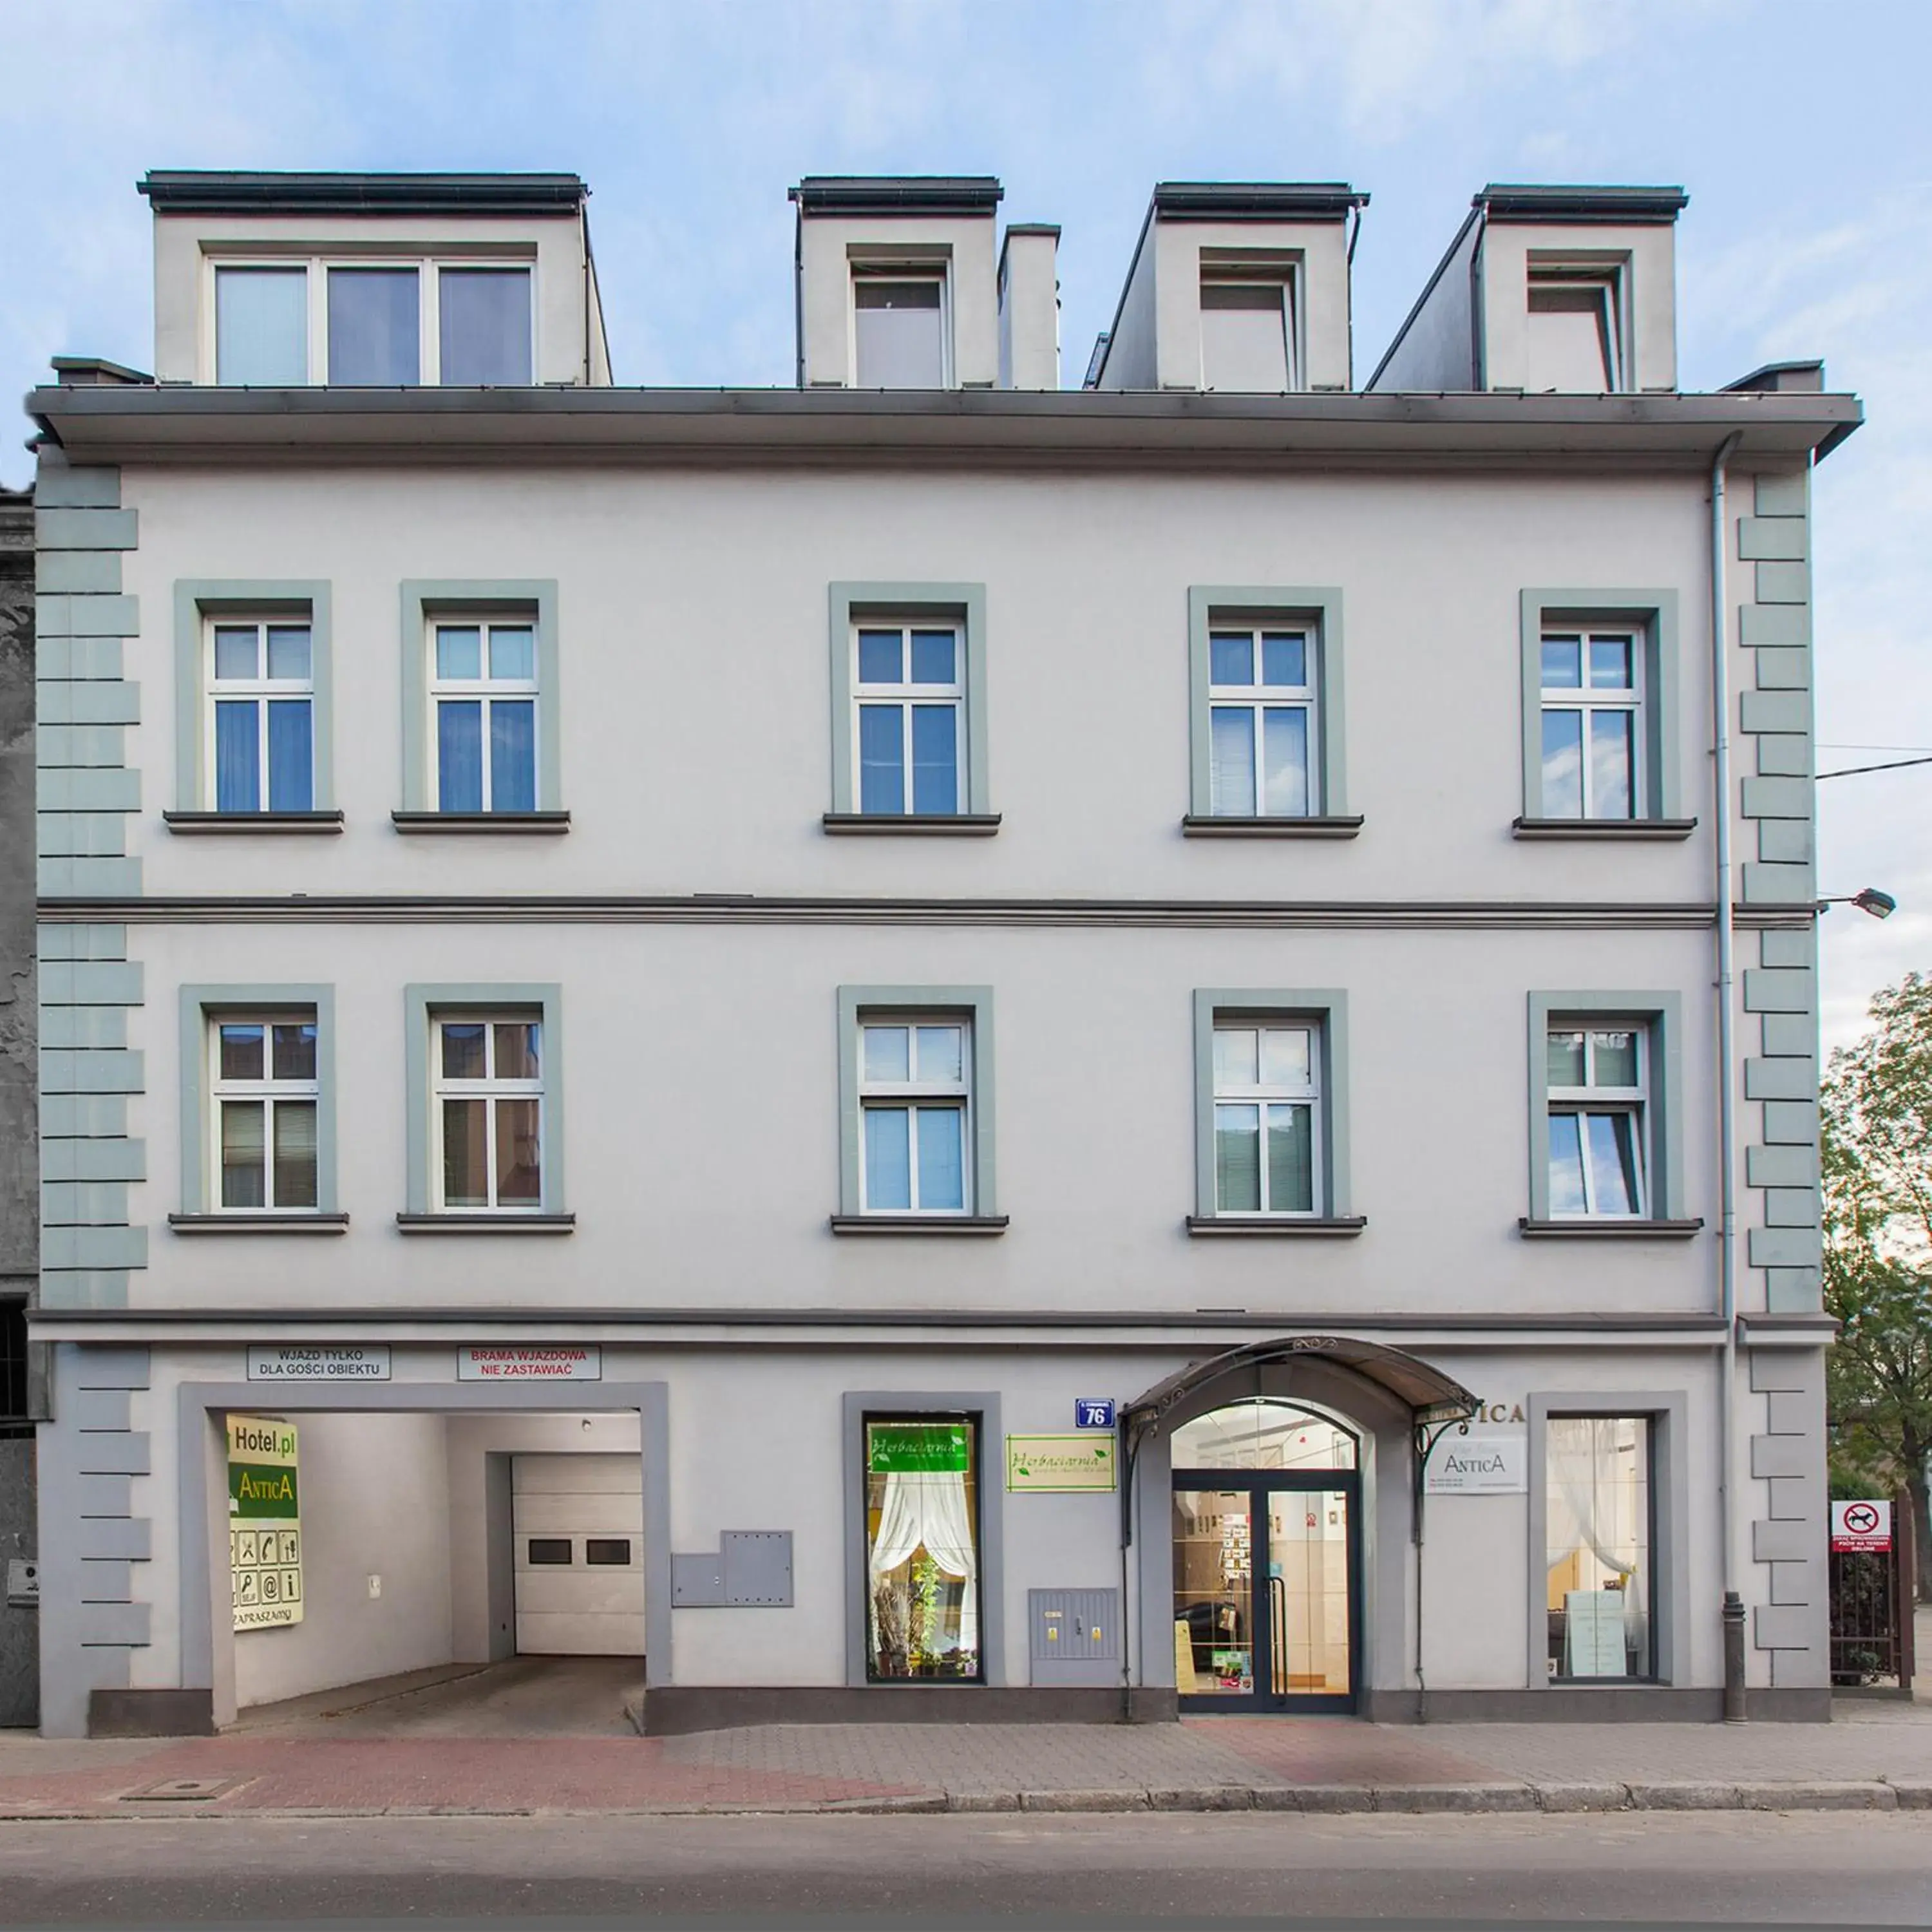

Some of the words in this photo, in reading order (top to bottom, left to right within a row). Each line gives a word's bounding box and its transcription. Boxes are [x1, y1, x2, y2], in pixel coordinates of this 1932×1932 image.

[279, 1350, 321, 1361] WJAZD
[325, 1350, 363, 1361] TYLKO
[471, 1350, 515, 1361] BRAMA
[517, 1350, 587, 1361] WJAZDOWA
[260, 1364, 283, 1374] DLA
[286, 1361, 325, 1375] GOŚCI
[327, 1364, 379, 1375] OBIEKTU
[481, 1365, 500, 1374] NIE
[504, 1362, 573, 1375] ZASTAWIAĆ
[1086, 1408, 1105, 1425] 76
[1468, 1404, 1526, 1423] ICA
[236, 1426, 294, 1459] Hotel.pl
